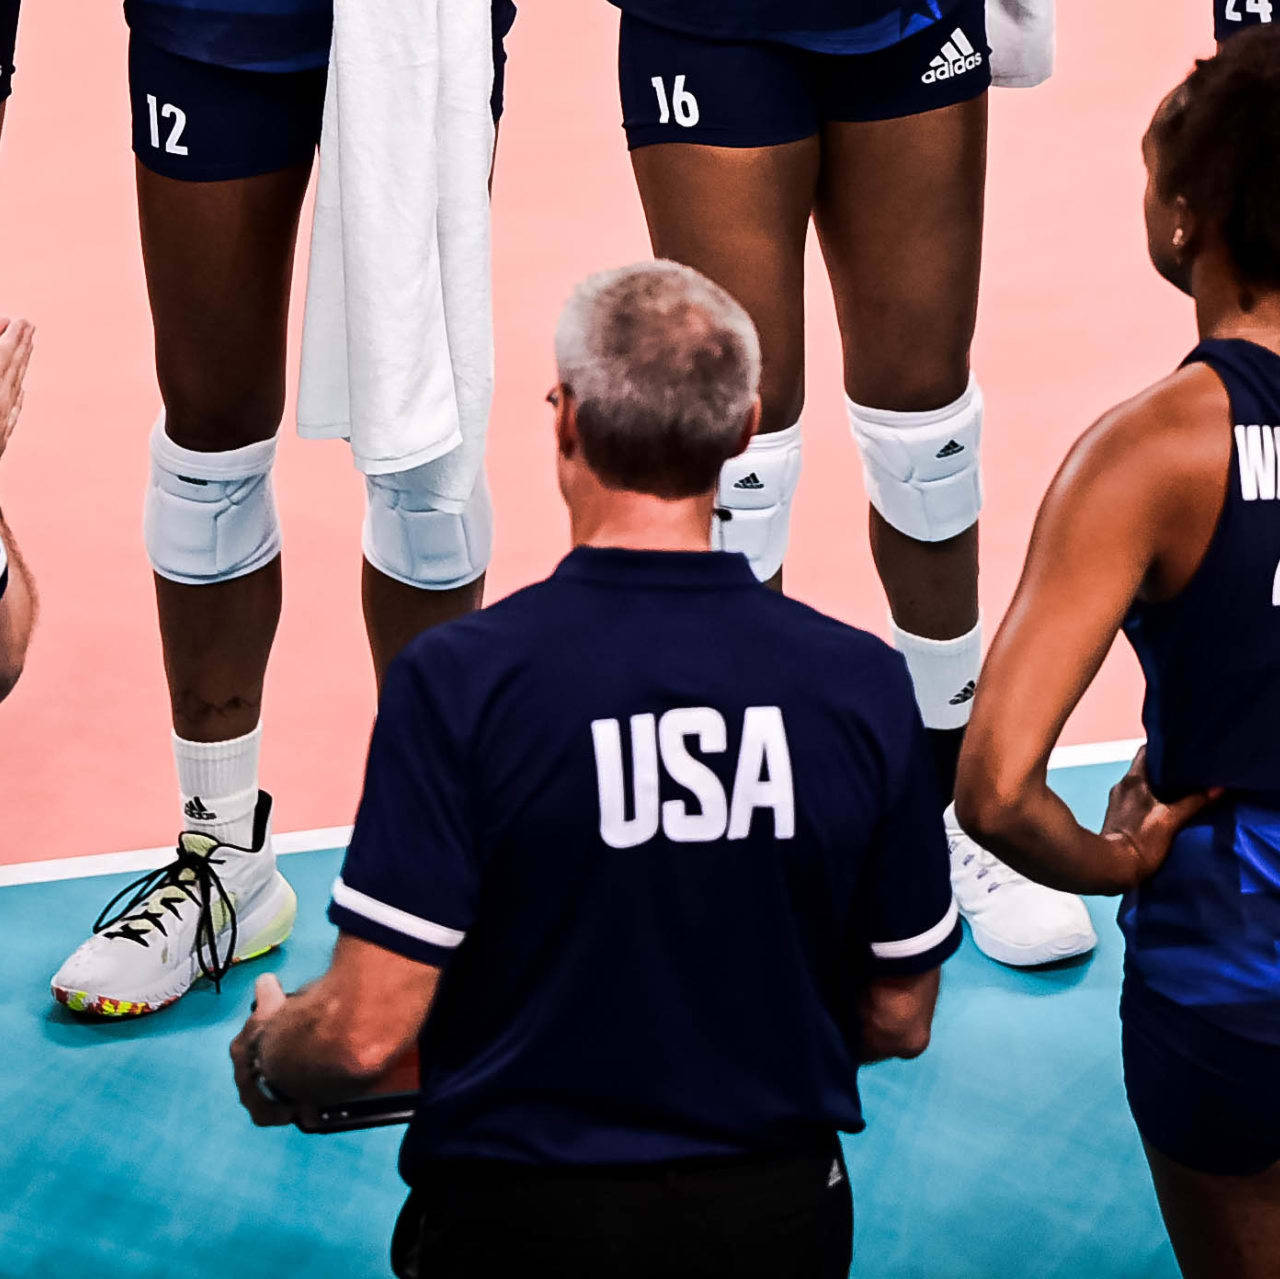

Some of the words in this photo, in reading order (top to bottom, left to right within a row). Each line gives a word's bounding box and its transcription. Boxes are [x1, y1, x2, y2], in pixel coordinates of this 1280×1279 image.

[921, 52, 982, 84] adidas
[147, 94, 189, 156] 12
[651, 75, 700, 127] 16
[591, 707, 795, 849] USA
